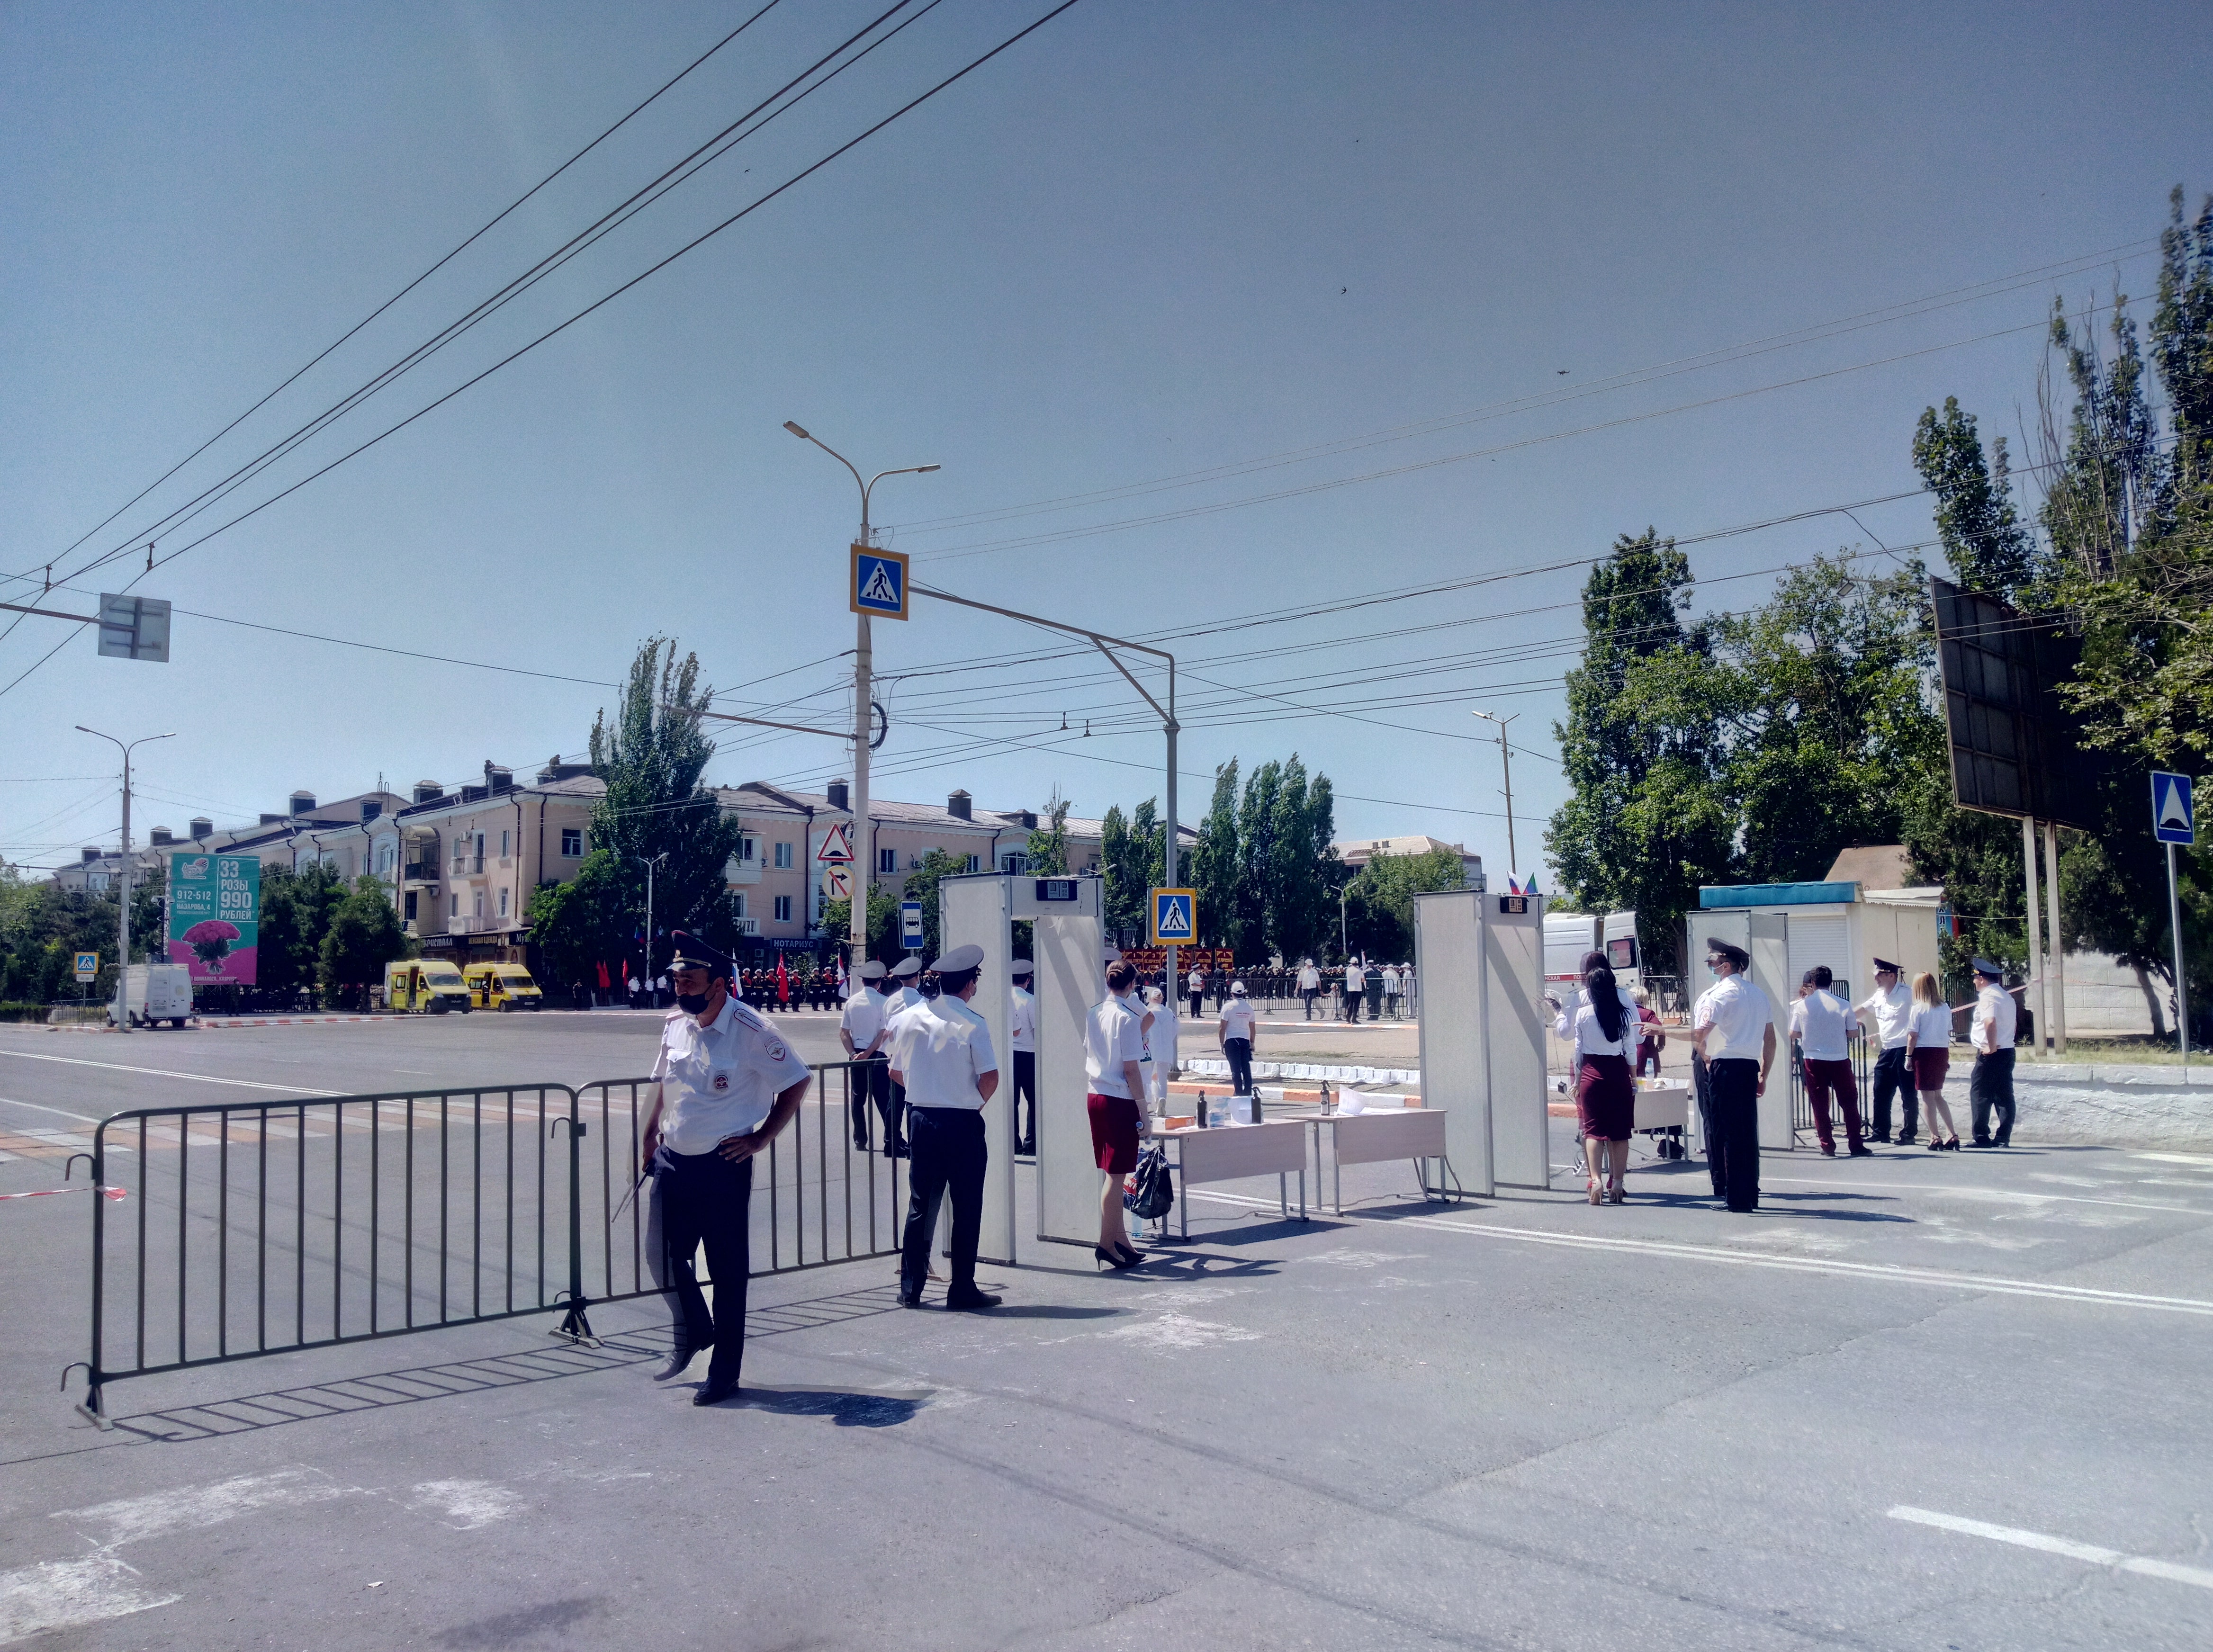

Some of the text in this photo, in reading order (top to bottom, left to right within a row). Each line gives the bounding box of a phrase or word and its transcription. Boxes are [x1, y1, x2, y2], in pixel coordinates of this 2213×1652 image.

[220, 861, 239, 878] 33
[221, 879, 248, 891] РОЗЫ
[177, 890, 211, 900] 912-512
[220, 891, 252, 908] 990
[220, 908, 251, 920] РУБЛЕЙ
